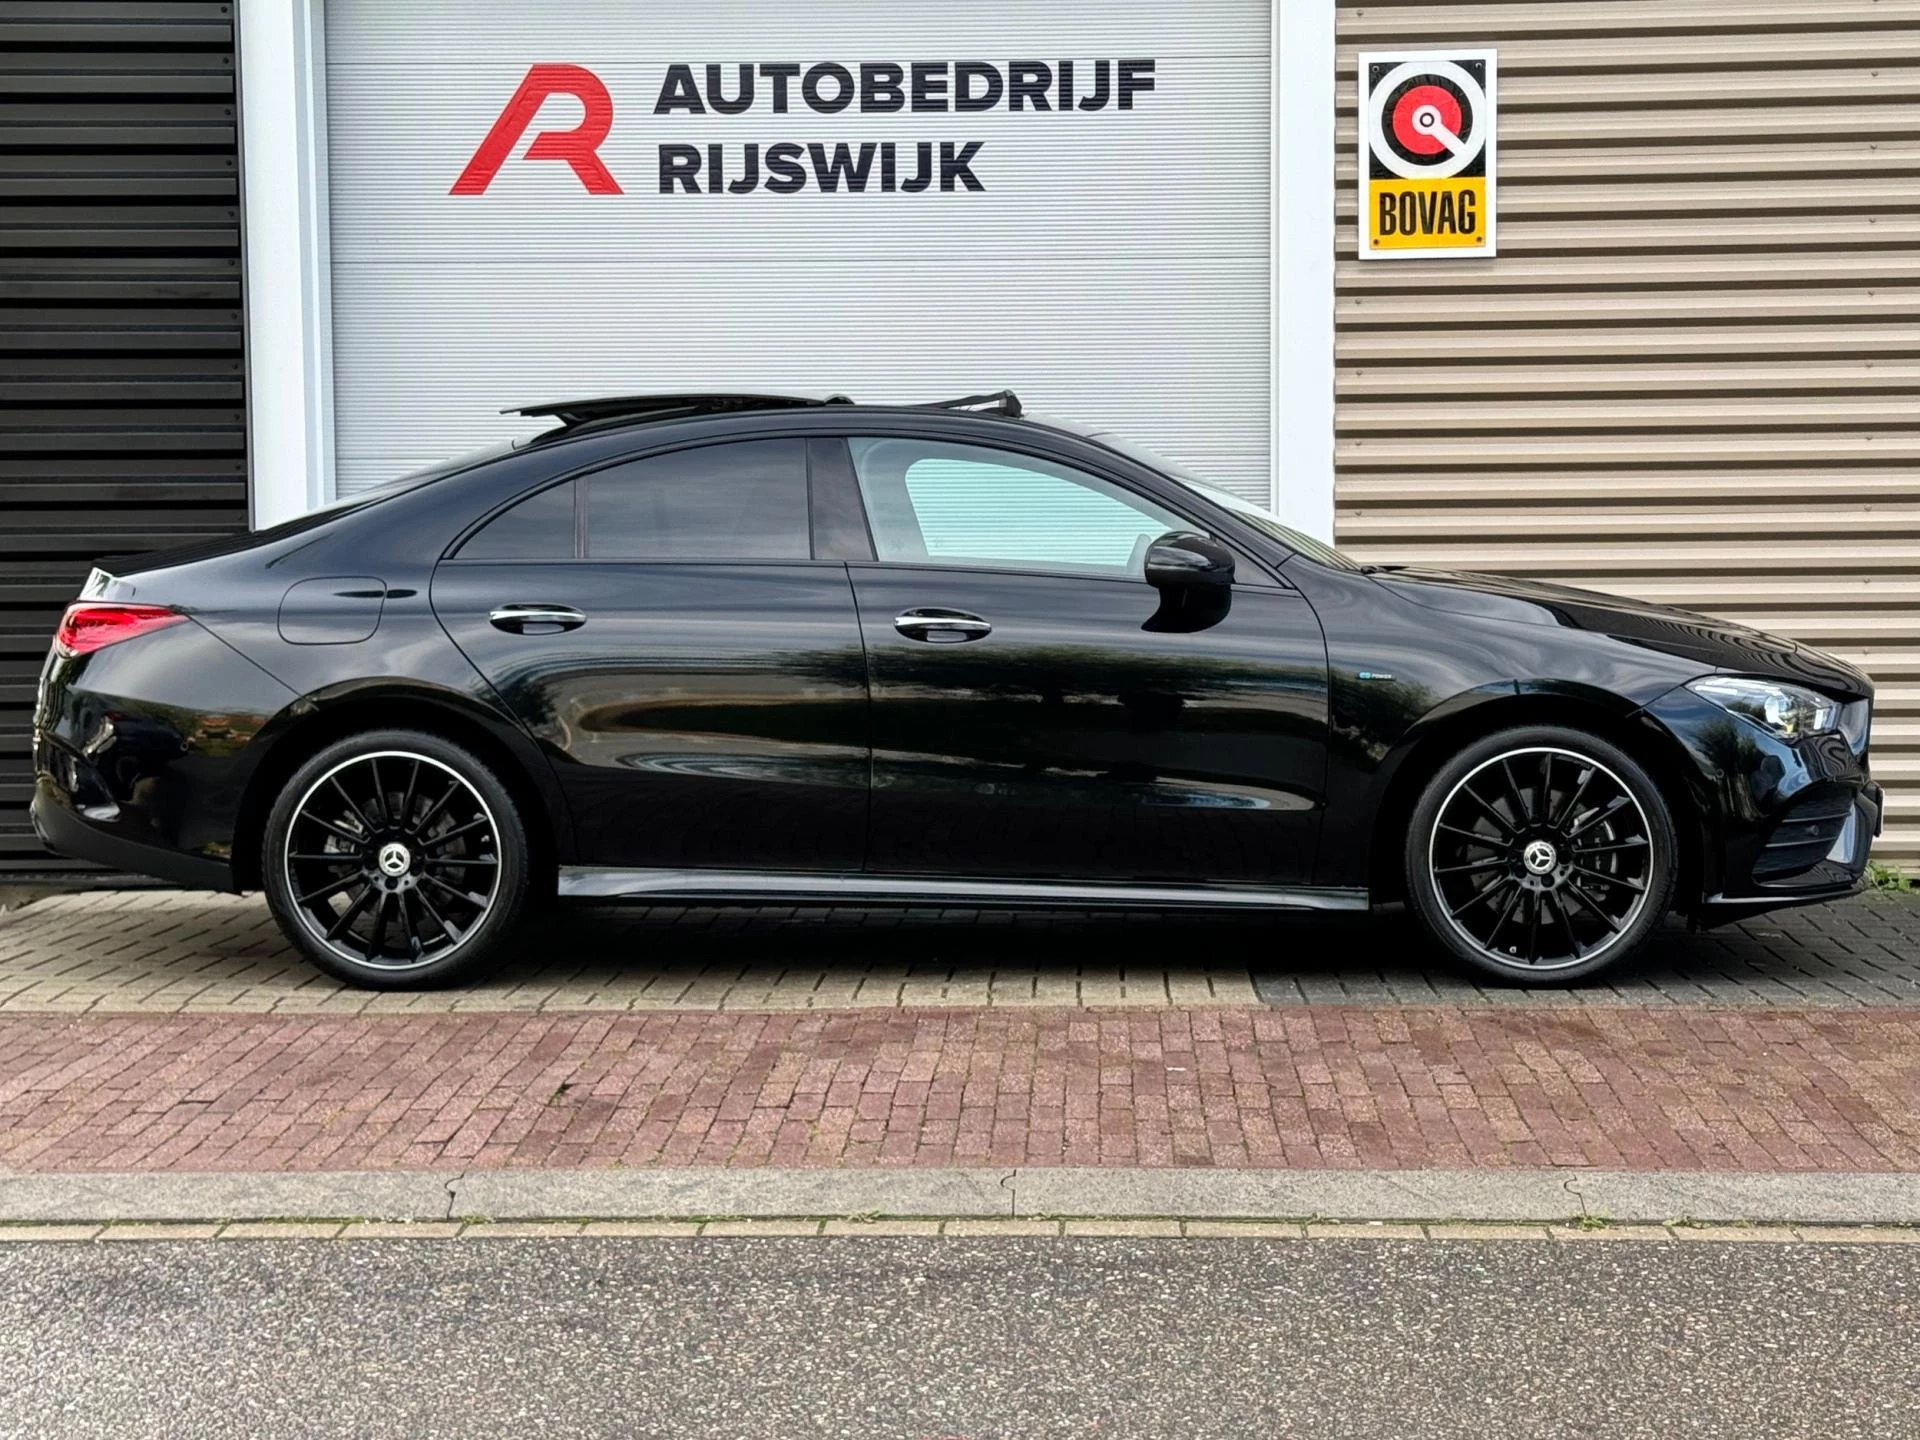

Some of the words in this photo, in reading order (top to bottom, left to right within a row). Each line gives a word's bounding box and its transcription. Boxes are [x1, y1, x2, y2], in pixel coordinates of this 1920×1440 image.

[653, 59, 1156, 115] AUTOBEDRIJF
[658, 141, 986, 194] RIJSWIJK
[1379, 189, 1476, 236] BOVAG
